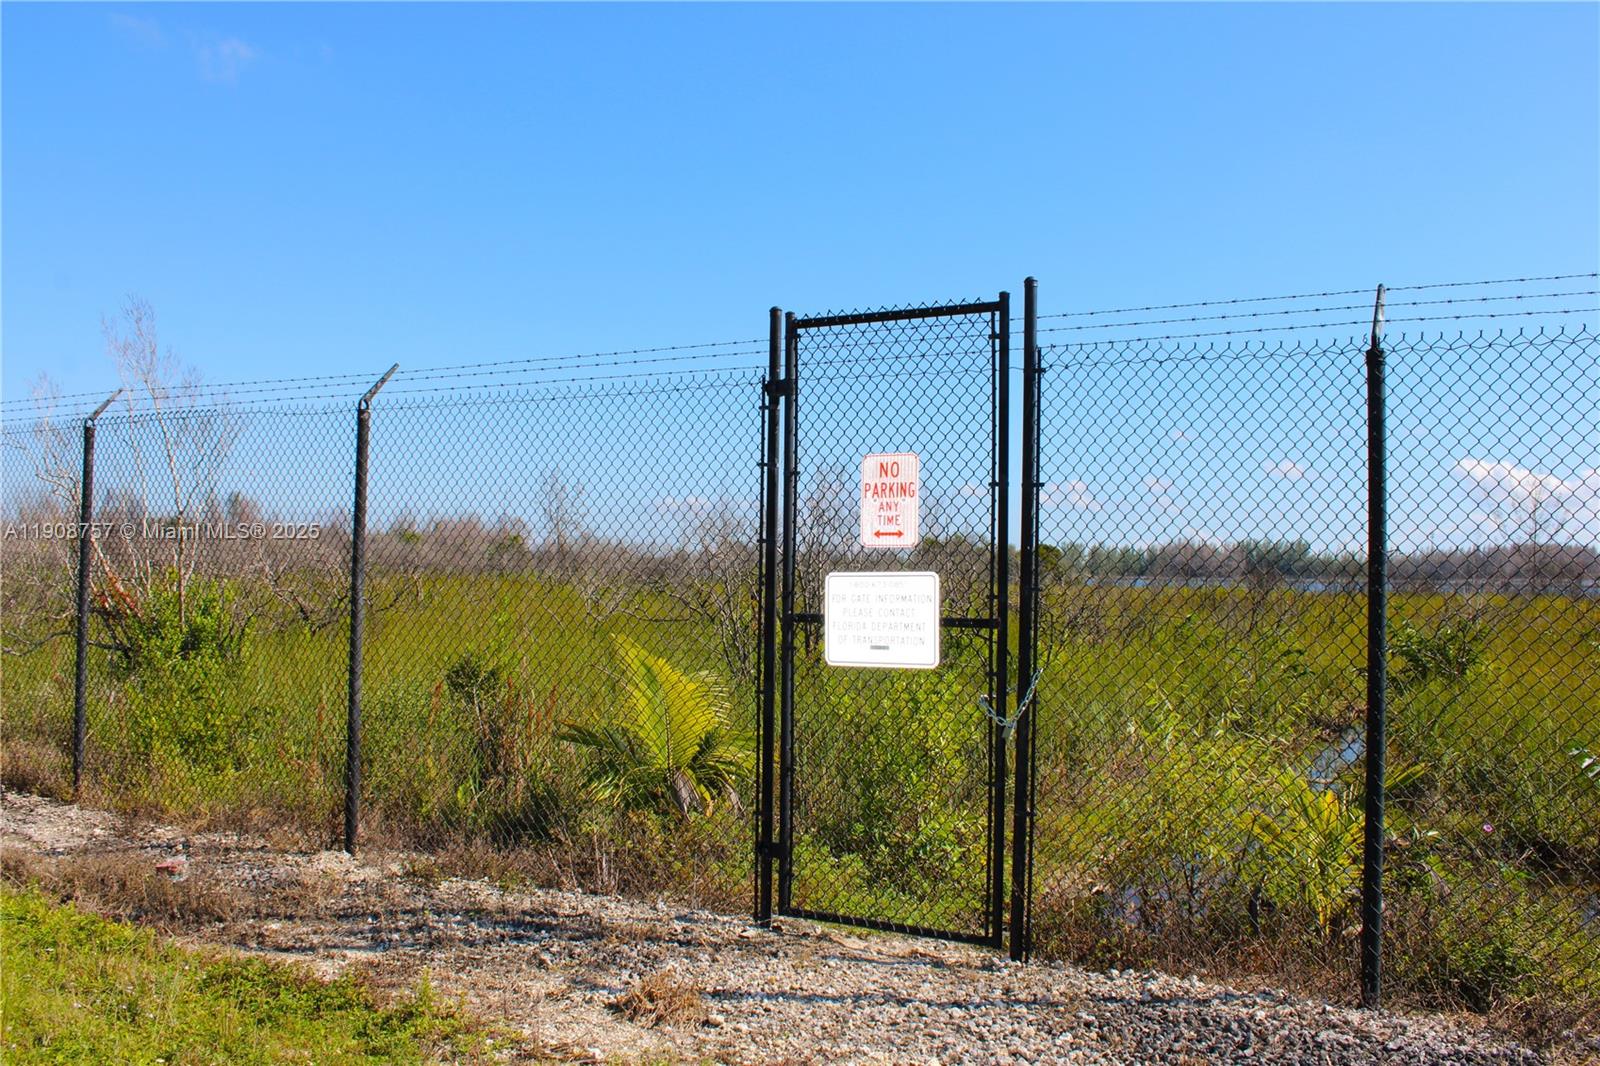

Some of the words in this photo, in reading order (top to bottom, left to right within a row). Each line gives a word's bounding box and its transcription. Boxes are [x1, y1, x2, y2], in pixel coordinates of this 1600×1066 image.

[879, 461, 900, 478] NO
[864, 481, 915, 499] PARKING
[878, 501, 900, 512] ANY
[878, 514, 901, 526] TIME
[832, 593, 848, 604] FOR
[851, 593, 870, 604] GATE
[875, 593, 933, 604] INFORMATION
[842, 607, 873, 618] PLEASE
[878, 607, 916, 618] CONTACT
[832, 621, 867, 632] FLORIDA
[871, 621, 926, 632] DEPARTMENT
[852, 634, 926, 646] TRANSPORTATION
